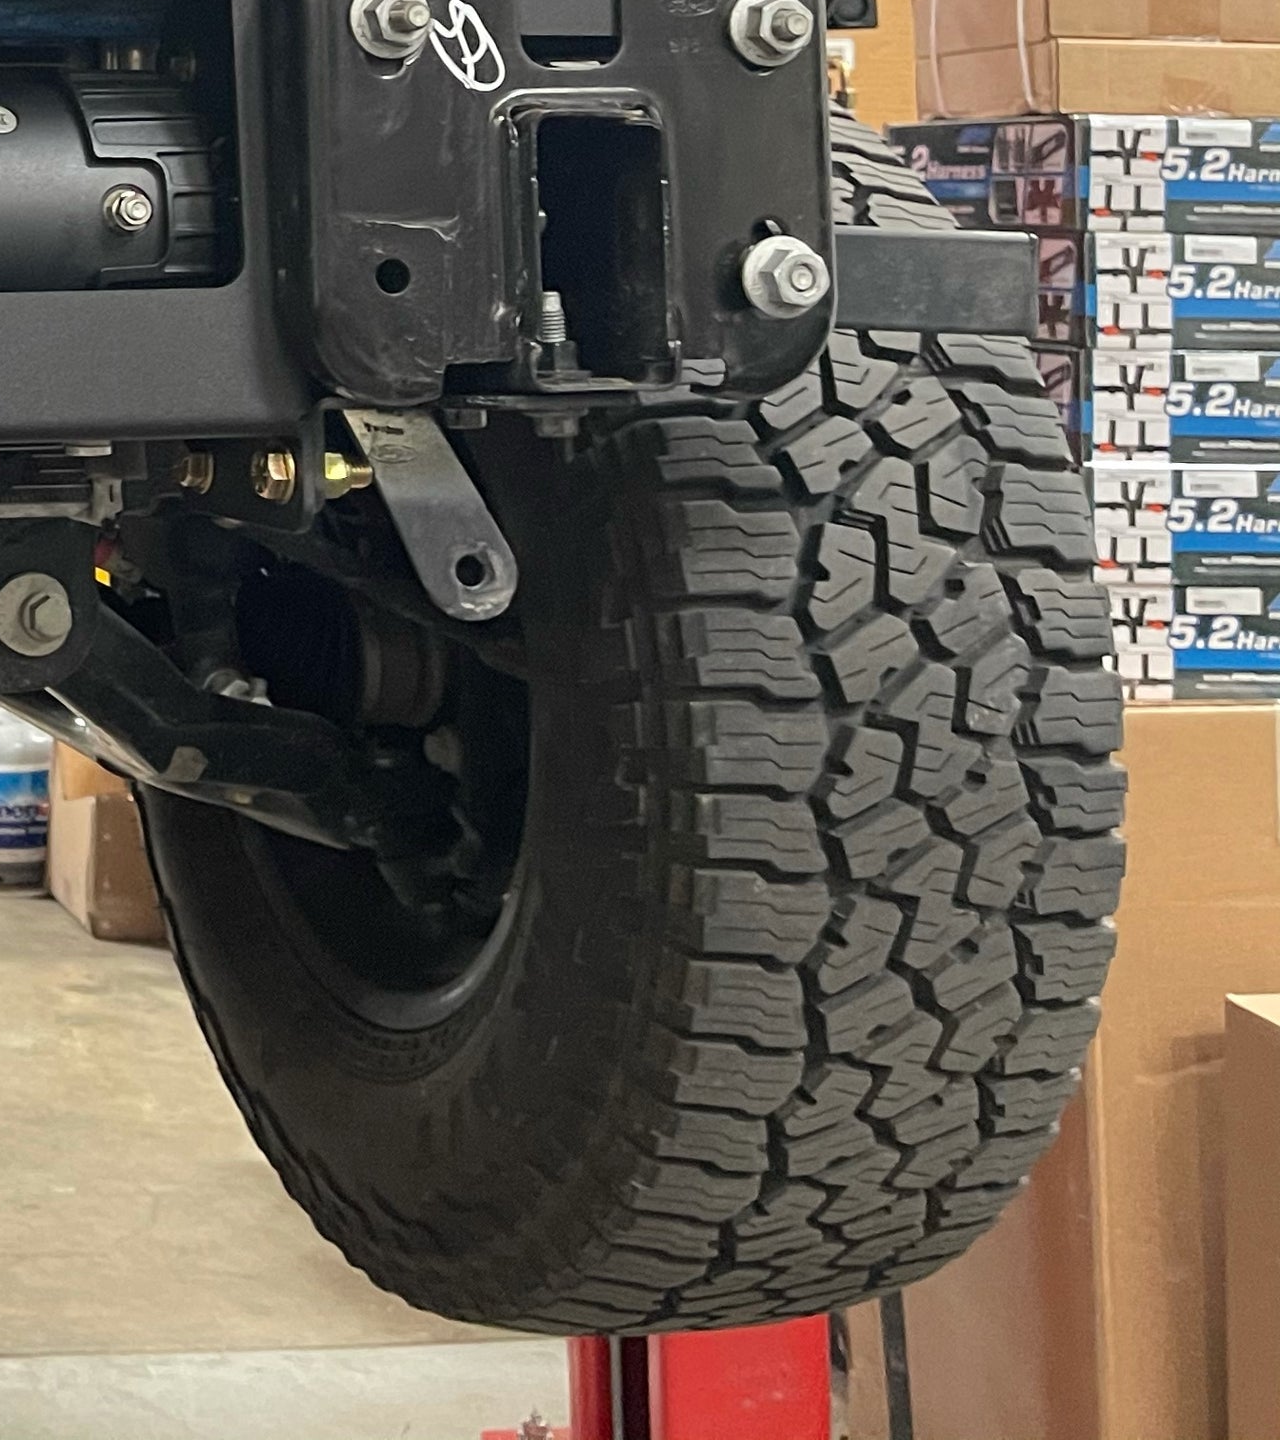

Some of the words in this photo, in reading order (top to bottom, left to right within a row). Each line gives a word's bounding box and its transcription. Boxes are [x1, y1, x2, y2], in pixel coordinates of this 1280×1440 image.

[1162, 148, 1230, 181] 5.2
[1167, 264, 1235, 299] 5.2
[1166, 382, 1235, 417] 5.2
[1167, 498, 1238, 533] 5.2
[1169, 615, 1239, 649] 5.2
